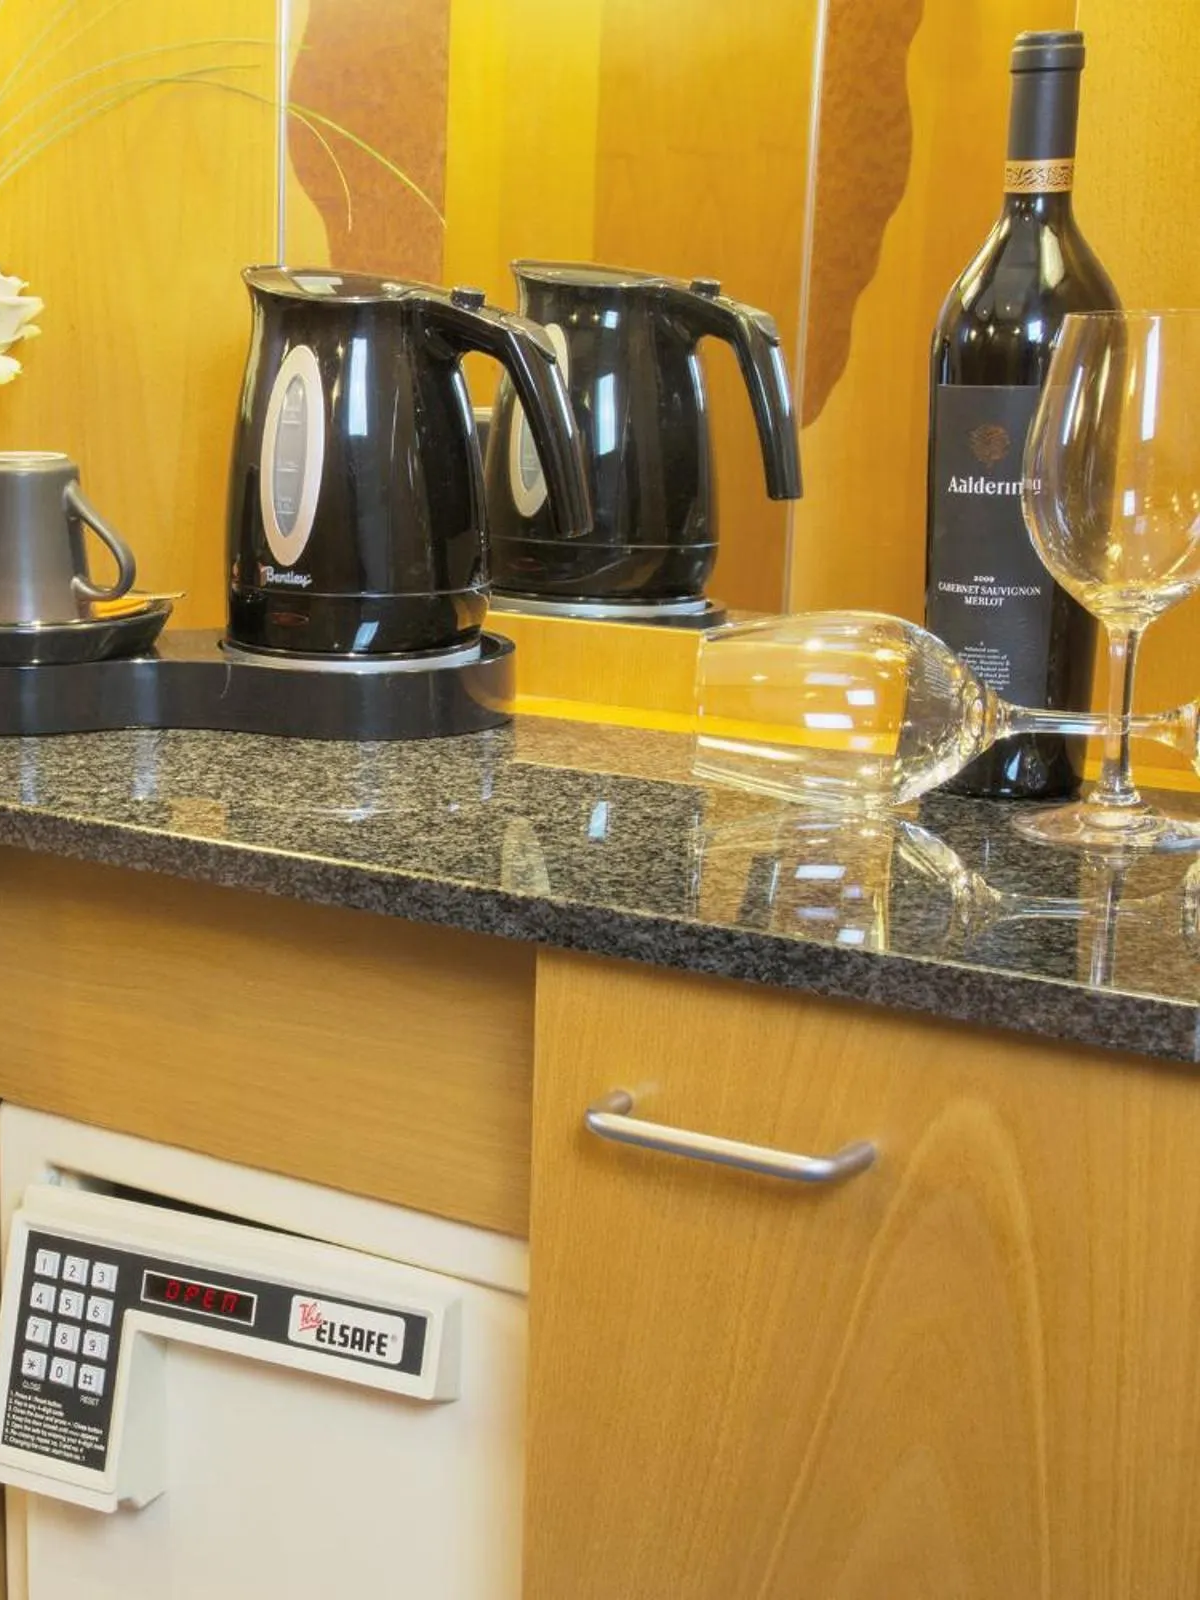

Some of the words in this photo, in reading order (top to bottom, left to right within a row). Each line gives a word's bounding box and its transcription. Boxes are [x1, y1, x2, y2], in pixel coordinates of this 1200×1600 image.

[938, 581, 980, 595] CABERNET
[980, 585, 1041, 596] SAUVIGNON
[963, 595, 1005, 607] MERLOT
[68, 1264, 77, 1278] 2
[98, 1270, 106, 1284] 3
[36, 1291, 44, 1305] 4
[64, 1298, 72, 1311] 5
[92, 1305, 100, 1319] 6
[299, 1301, 322, 1331] The
[32, 1323, 40, 1337] 7
[60, 1332, 68, 1345] 8
[88, 1339, 97, 1352] 9
[314, 1319, 389, 1357] ELSAFE
